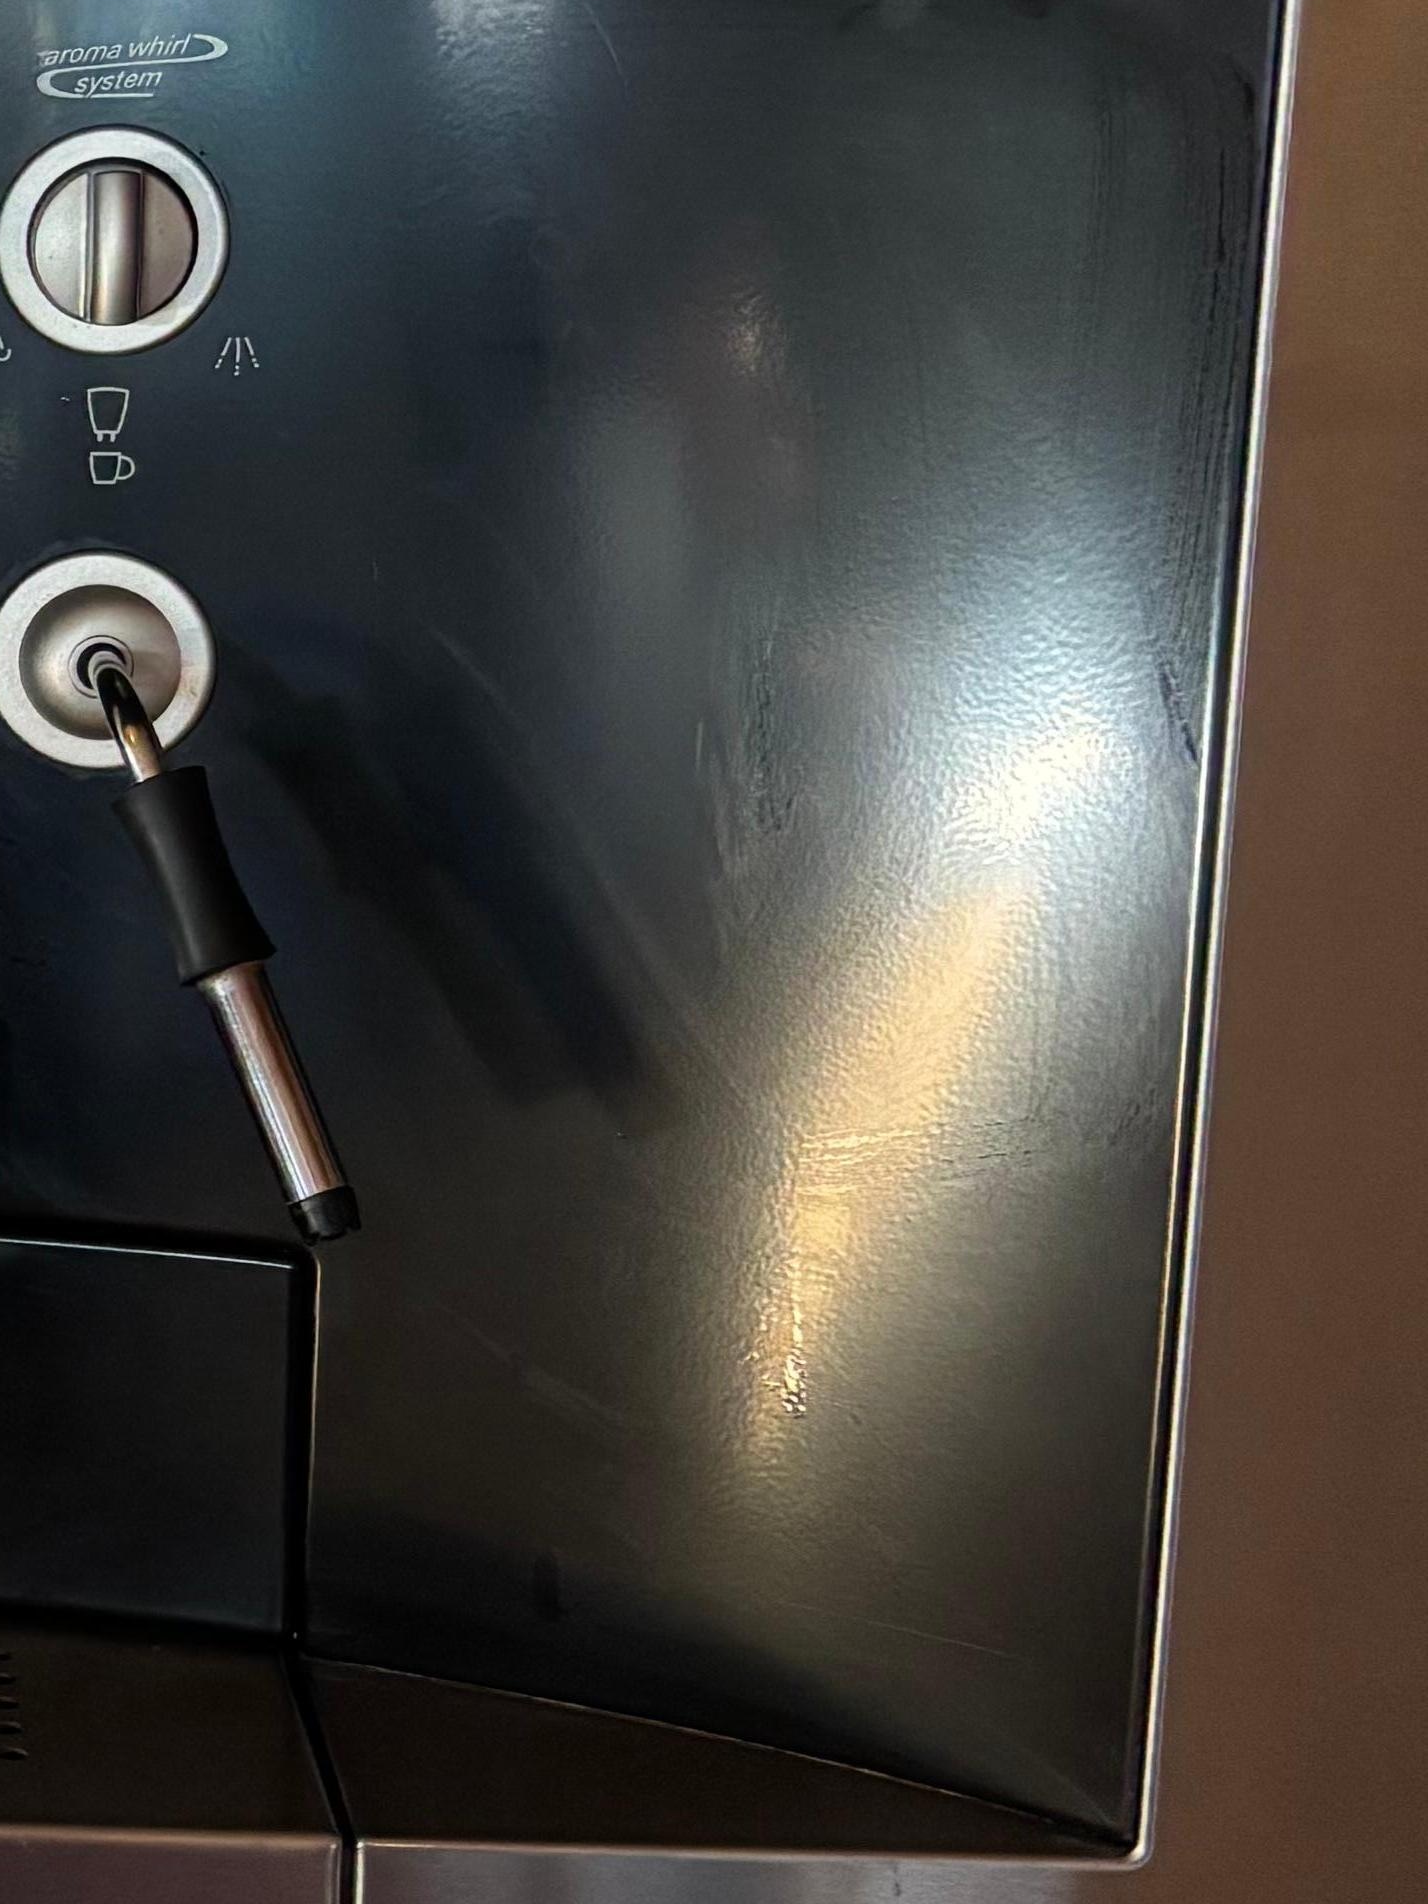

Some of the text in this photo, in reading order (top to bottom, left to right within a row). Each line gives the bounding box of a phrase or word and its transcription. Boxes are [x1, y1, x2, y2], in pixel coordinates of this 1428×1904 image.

[43, 33, 192, 67] aroma whirl
[73, 70, 163, 99] system
